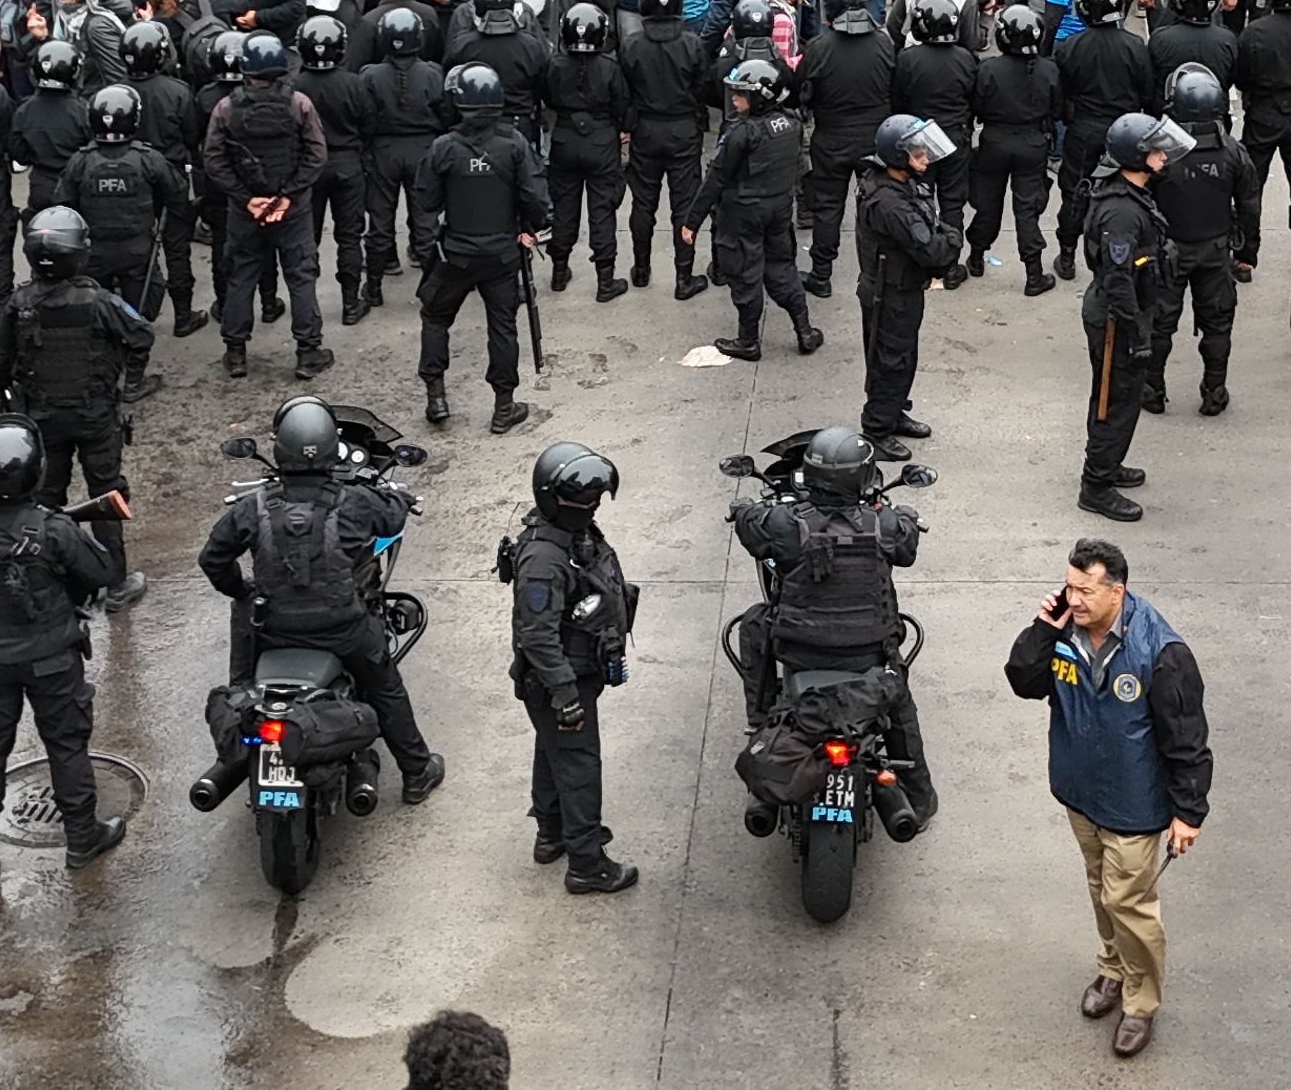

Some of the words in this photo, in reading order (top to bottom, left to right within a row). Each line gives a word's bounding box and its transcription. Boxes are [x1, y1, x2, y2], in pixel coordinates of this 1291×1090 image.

[770, 116, 791, 132] PFA
[1185, 163, 1218, 178] FA
[98, 178, 127, 192] PFA
[1051, 658, 1079, 685] PFA
[826, 774, 854, 791] 951
[259, 790, 301, 807] PFA
[825, 790, 855, 808] ETM
[812, 807, 853, 823] PFA
